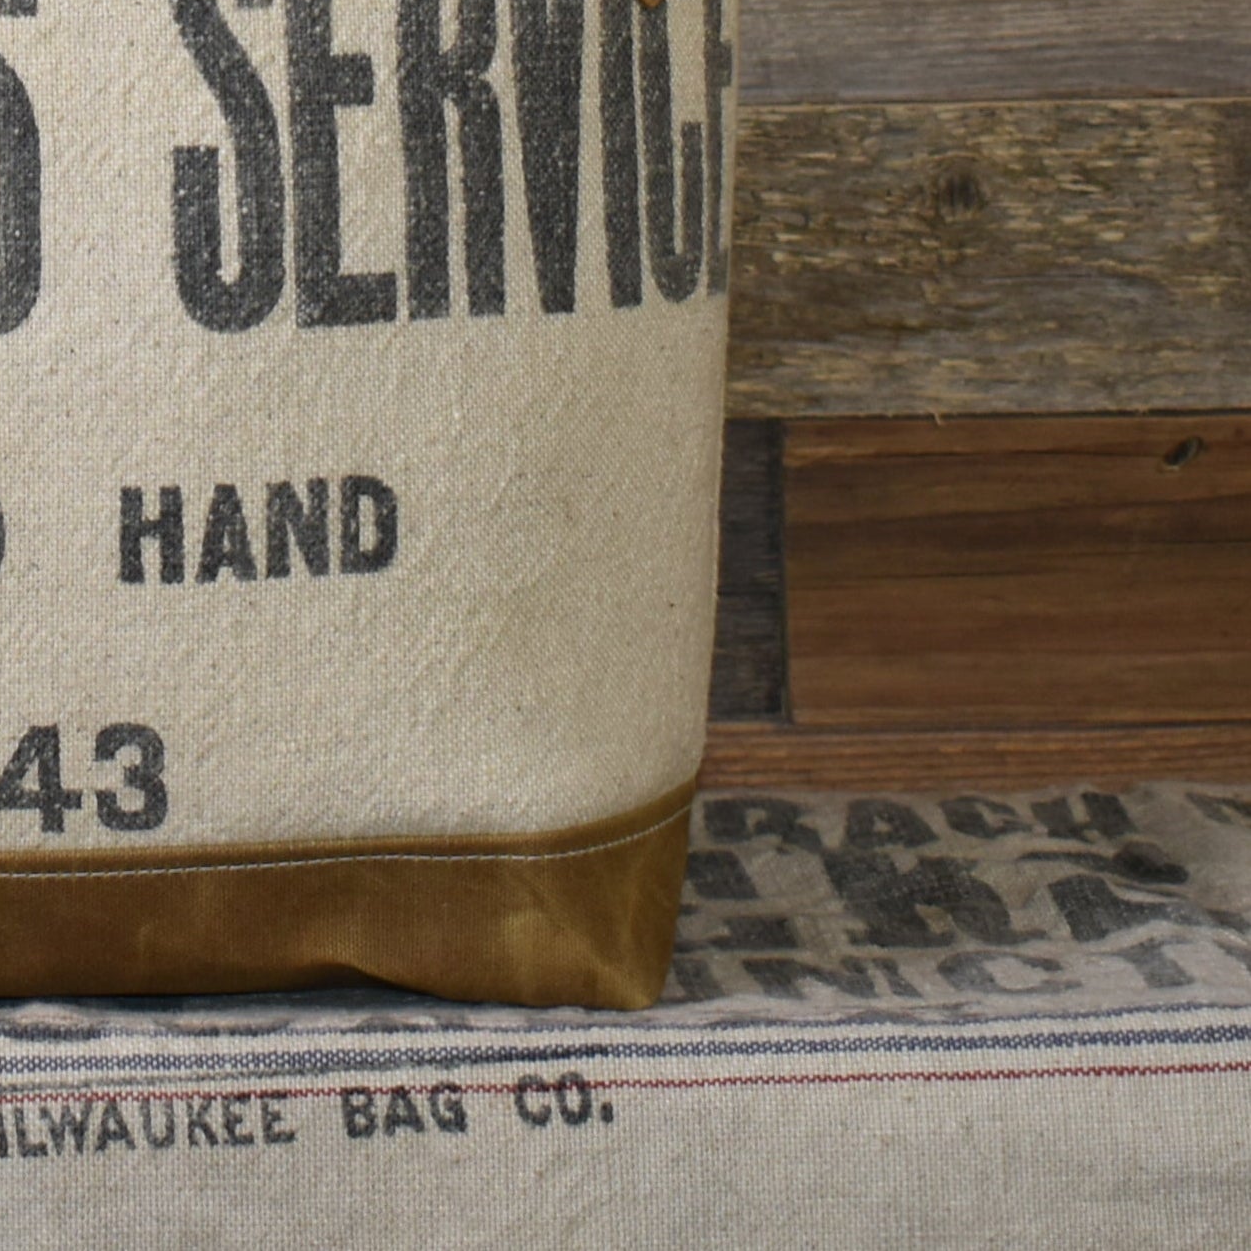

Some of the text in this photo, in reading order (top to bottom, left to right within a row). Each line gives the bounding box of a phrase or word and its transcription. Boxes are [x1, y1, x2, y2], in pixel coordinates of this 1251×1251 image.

[119, 475, 399, 584] HAND
[340, 1080, 469, 1139] BAG
[513, 1071, 615, 1127] CO.
